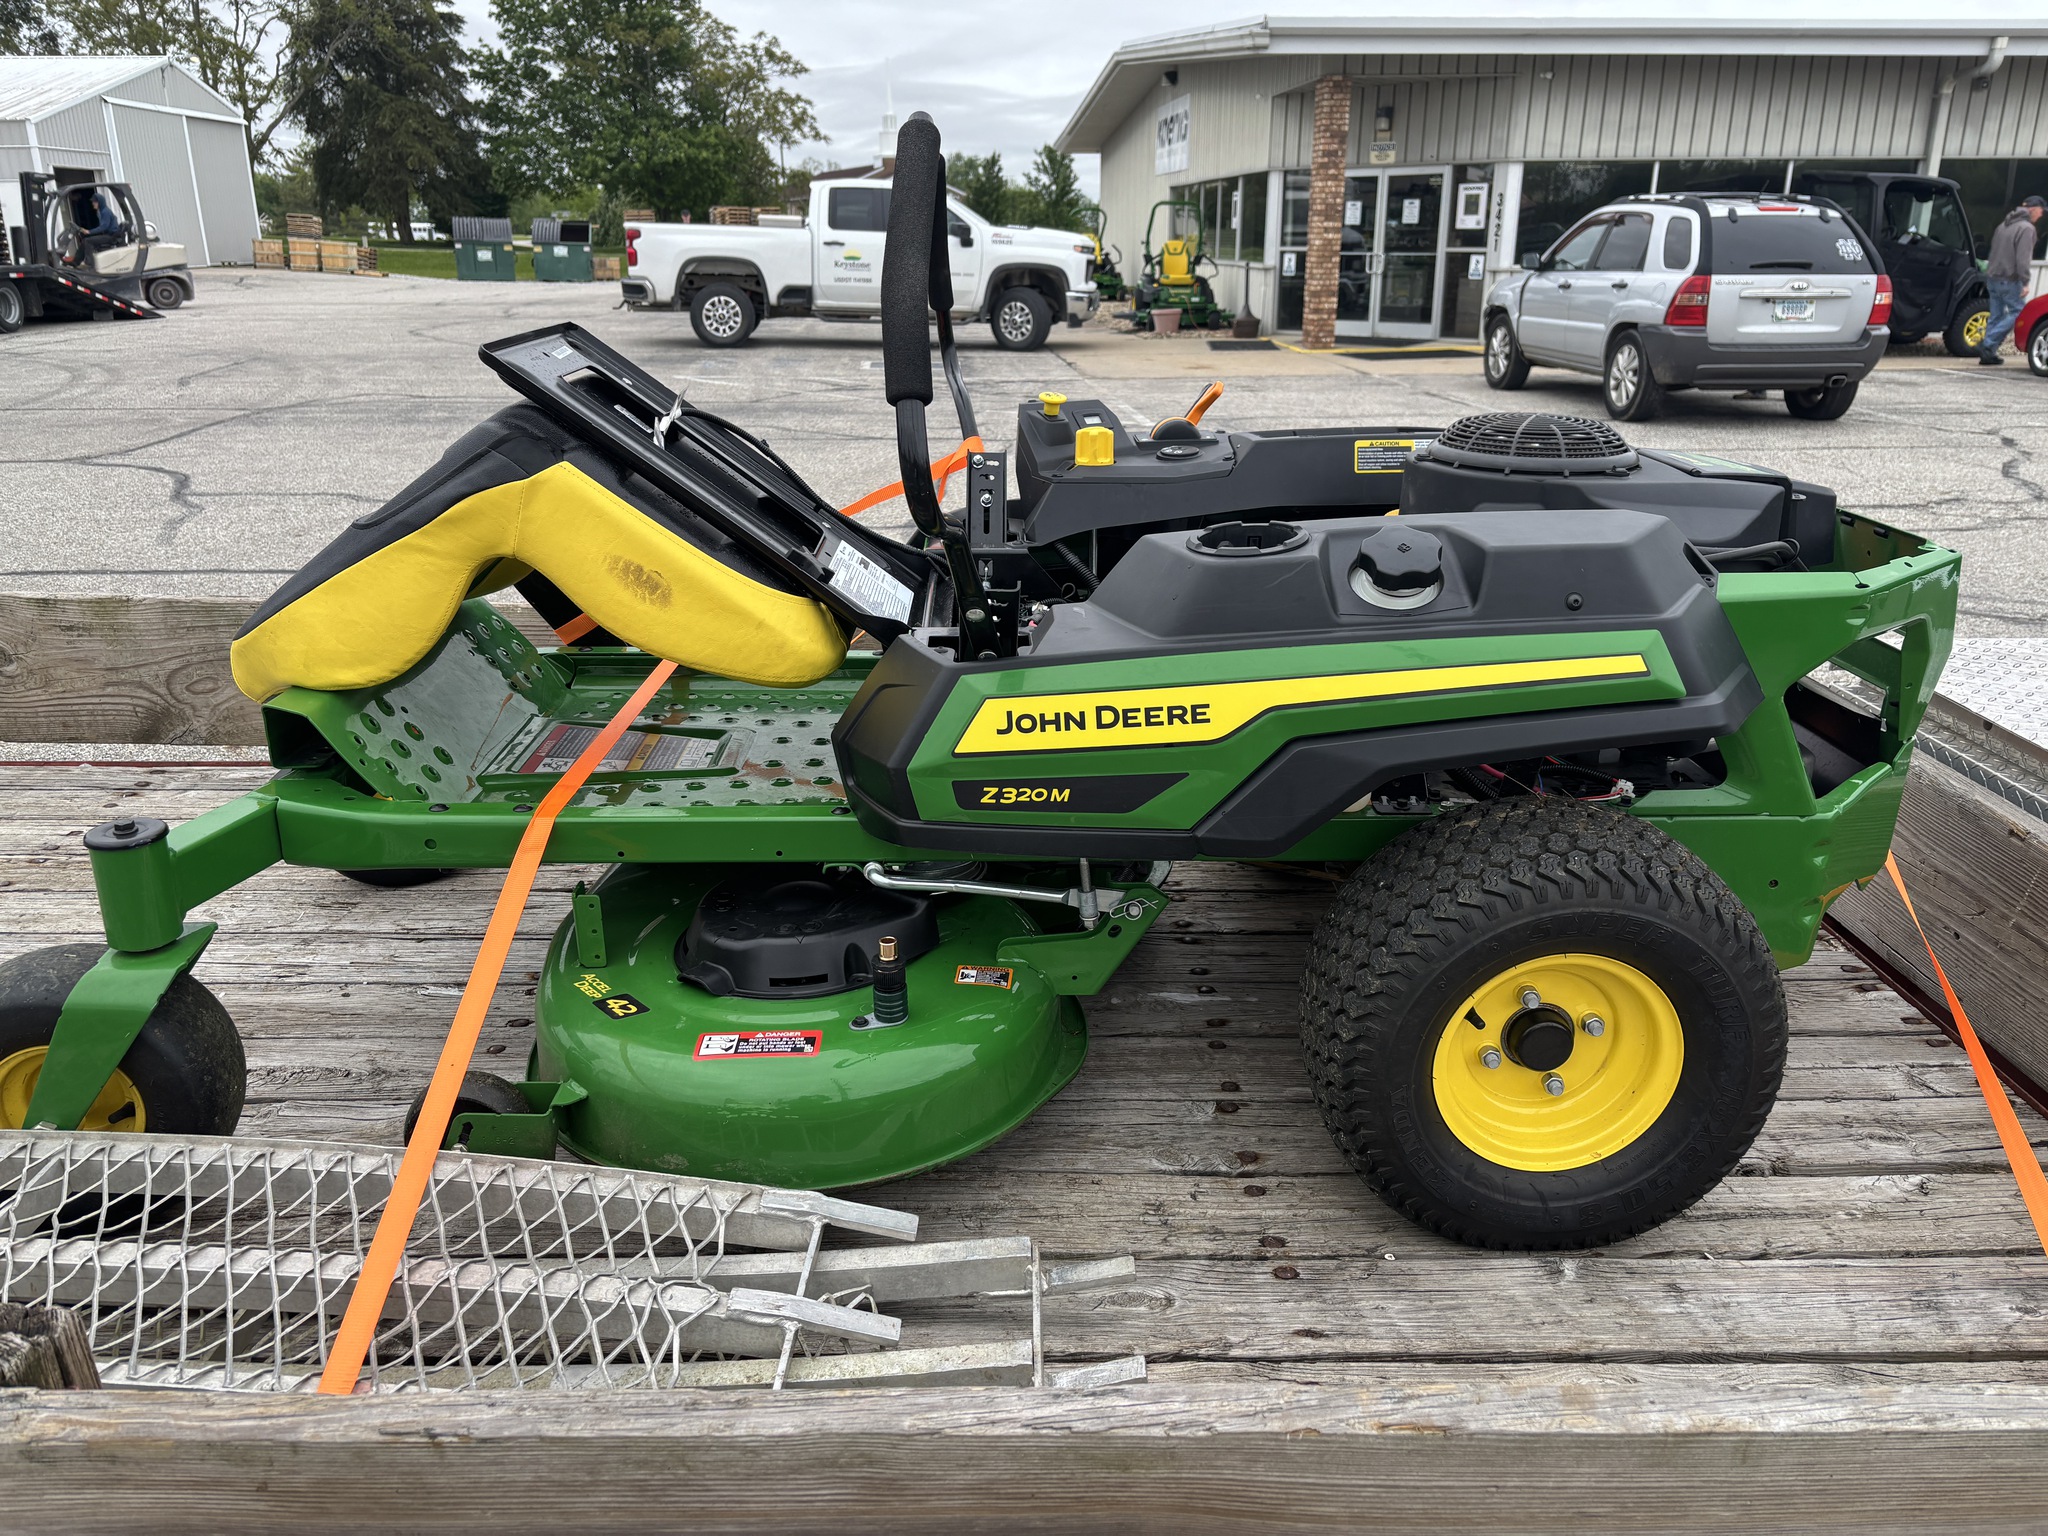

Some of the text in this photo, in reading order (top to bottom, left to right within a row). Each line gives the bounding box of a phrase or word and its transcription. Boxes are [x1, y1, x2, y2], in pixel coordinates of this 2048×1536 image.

[834, 260, 872, 270] Keystone
[996, 703, 1211, 735] JOHN DEERE
[1527, 911, 1675, 950] SUPER
[573, 980, 603, 998] DEEP
[580, 973, 612, 994] ACCEL
[606, 999, 638, 1017] 42
[1688, 953, 1752, 1042] TURF
[1390, 1084, 1456, 1199] KENDA
